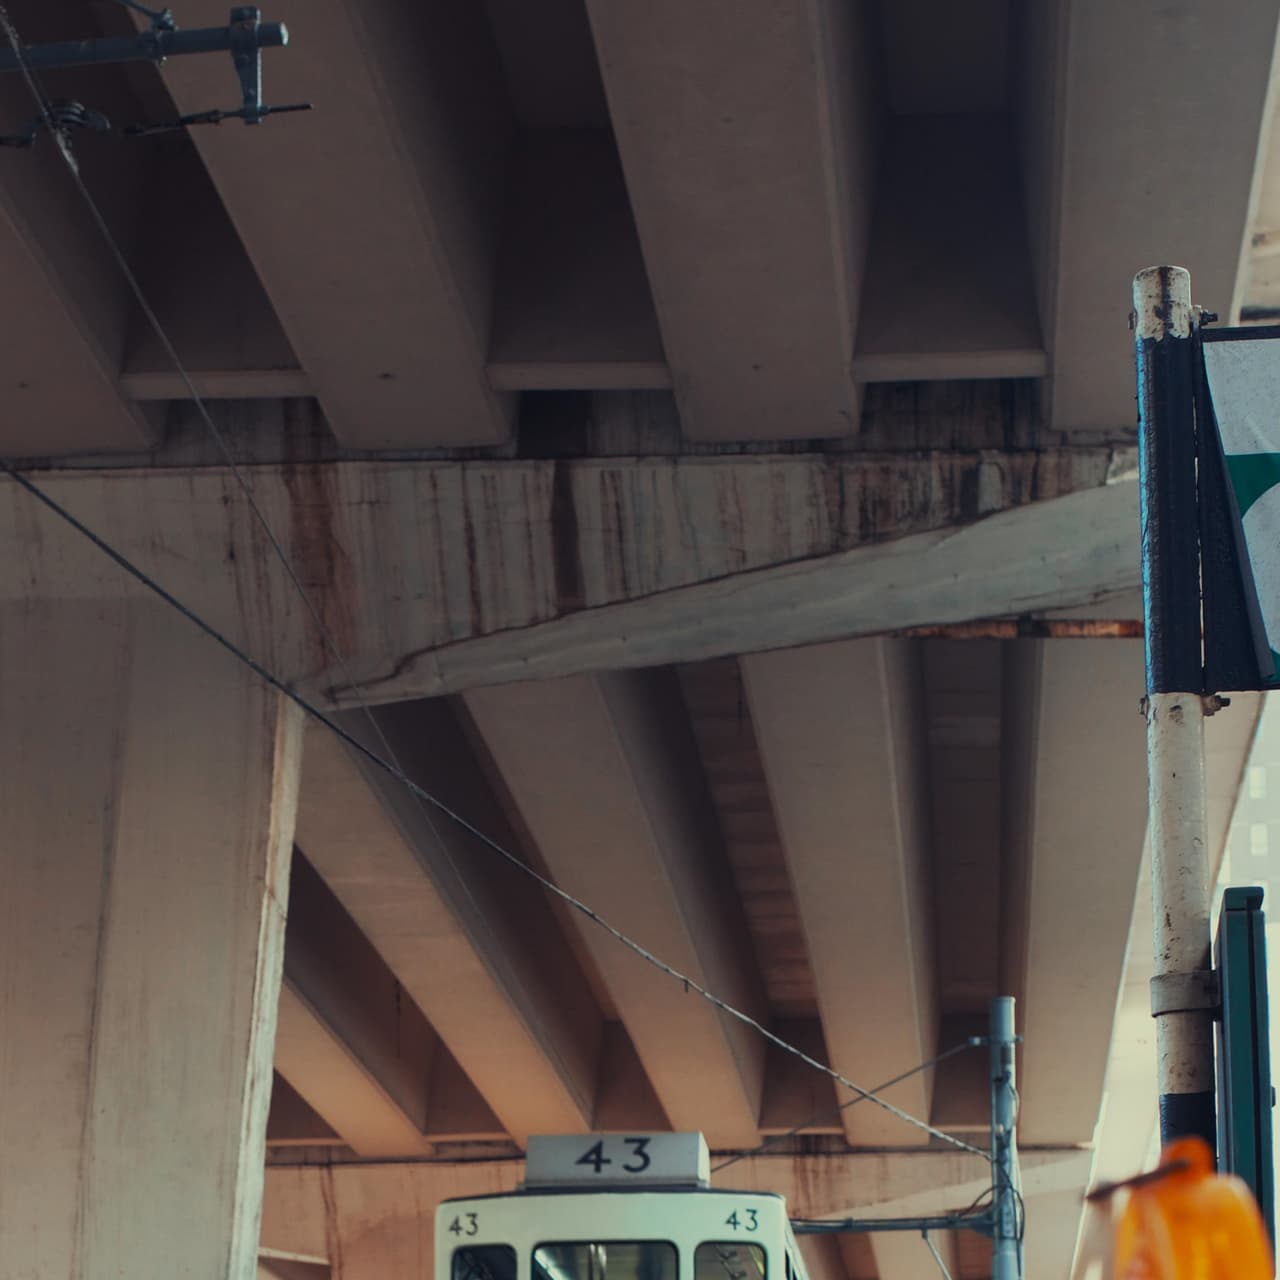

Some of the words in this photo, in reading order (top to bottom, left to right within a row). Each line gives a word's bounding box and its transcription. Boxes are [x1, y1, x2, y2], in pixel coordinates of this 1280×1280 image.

[576, 1137, 651, 1174] 43
[449, 1213, 479, 1237] 43
[725, 1209, 759, 1232] 43
